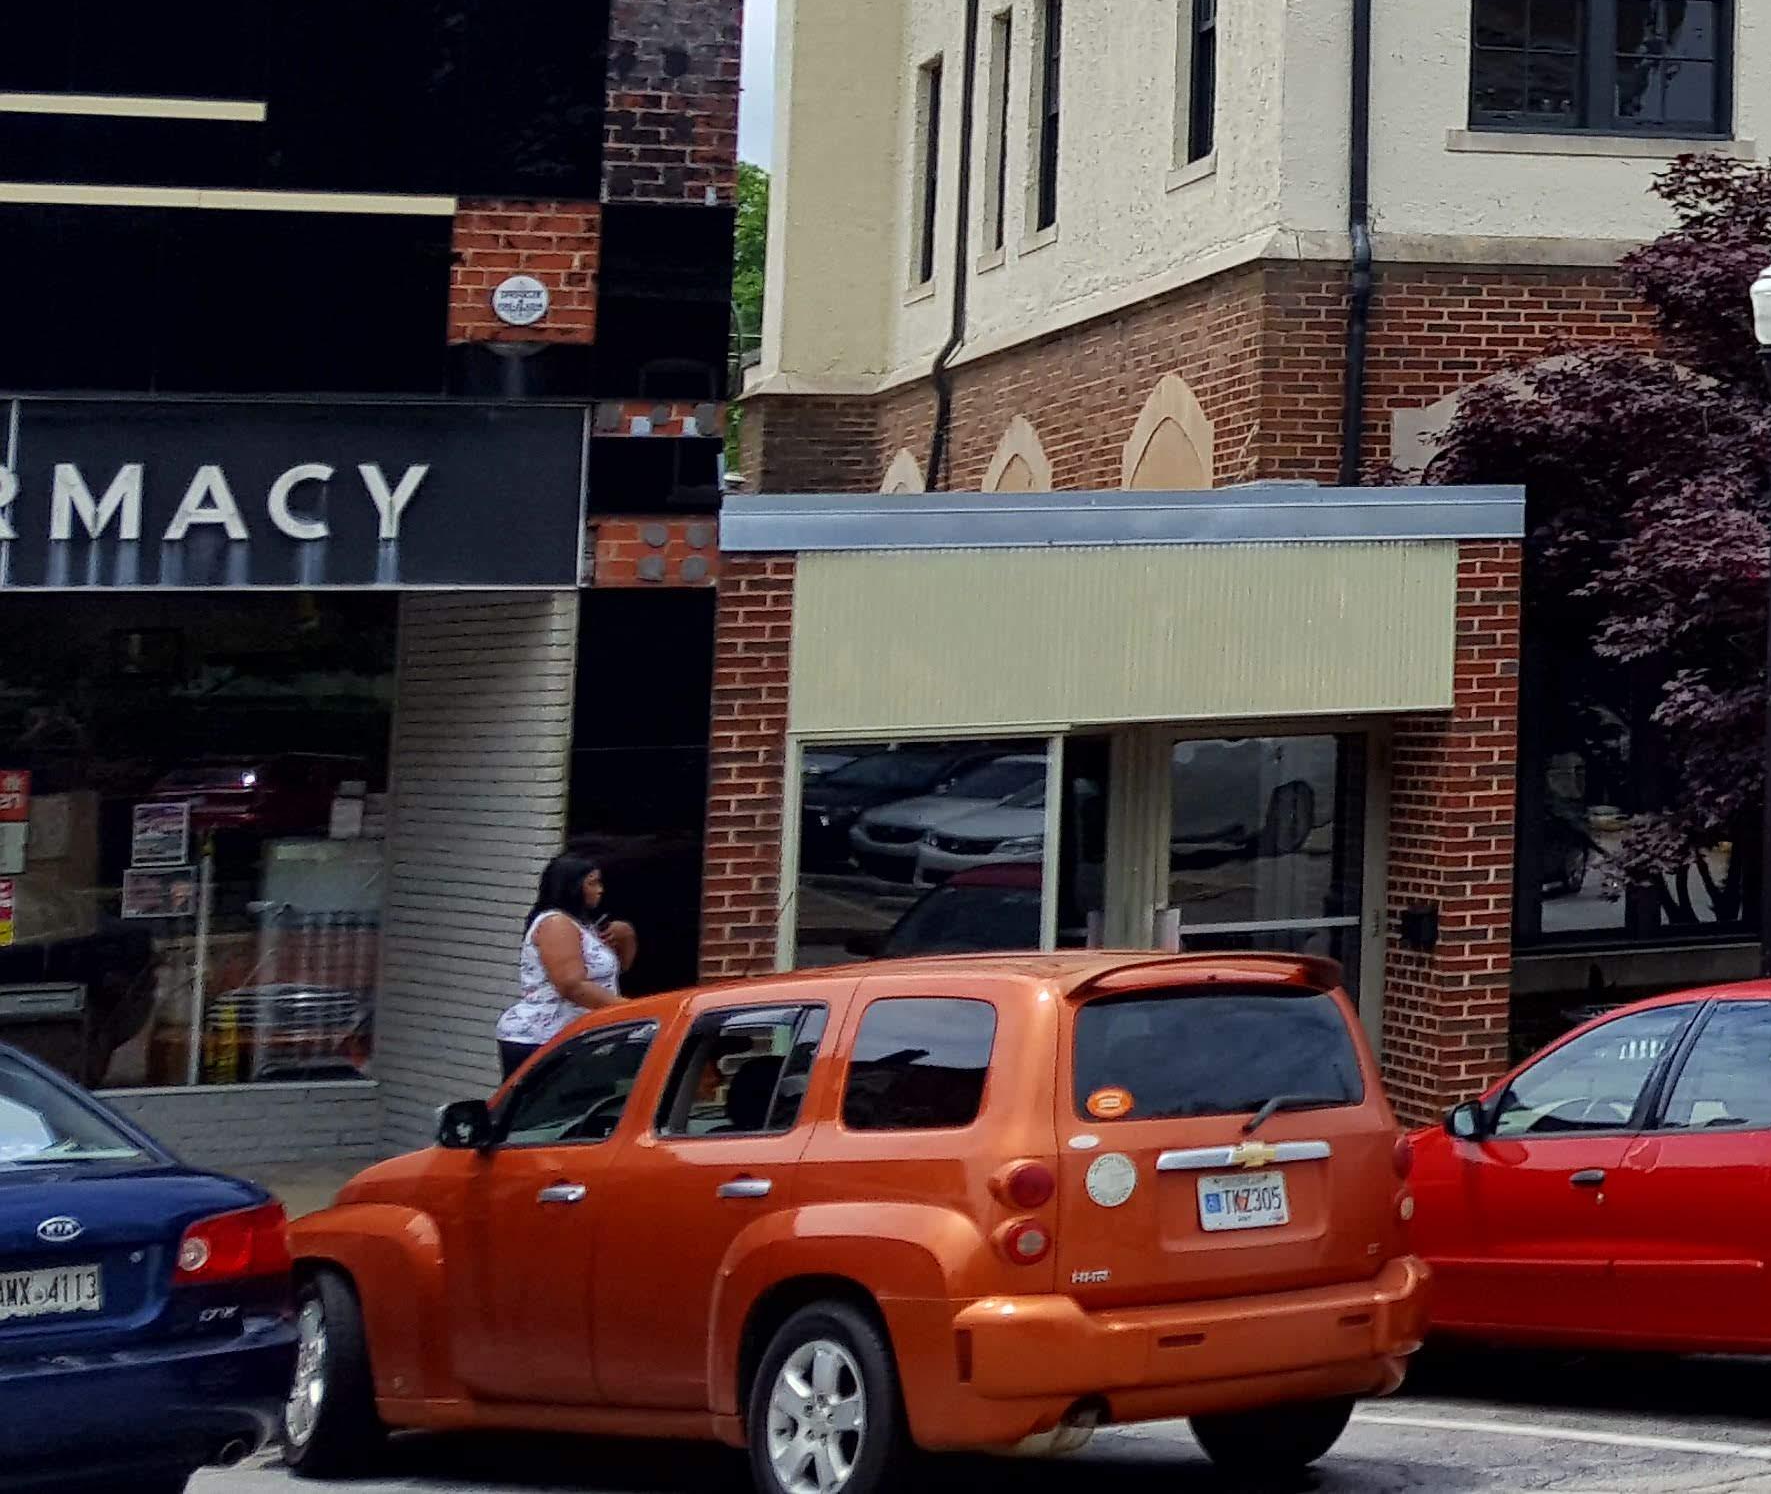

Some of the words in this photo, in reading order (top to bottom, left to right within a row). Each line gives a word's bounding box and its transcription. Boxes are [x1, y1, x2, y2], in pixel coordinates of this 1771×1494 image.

[42, 1220, 76, 1235] KIA
[1071, 1270, 1109, 1284] HHR
[49, 1271, 96, 1303] 4113
